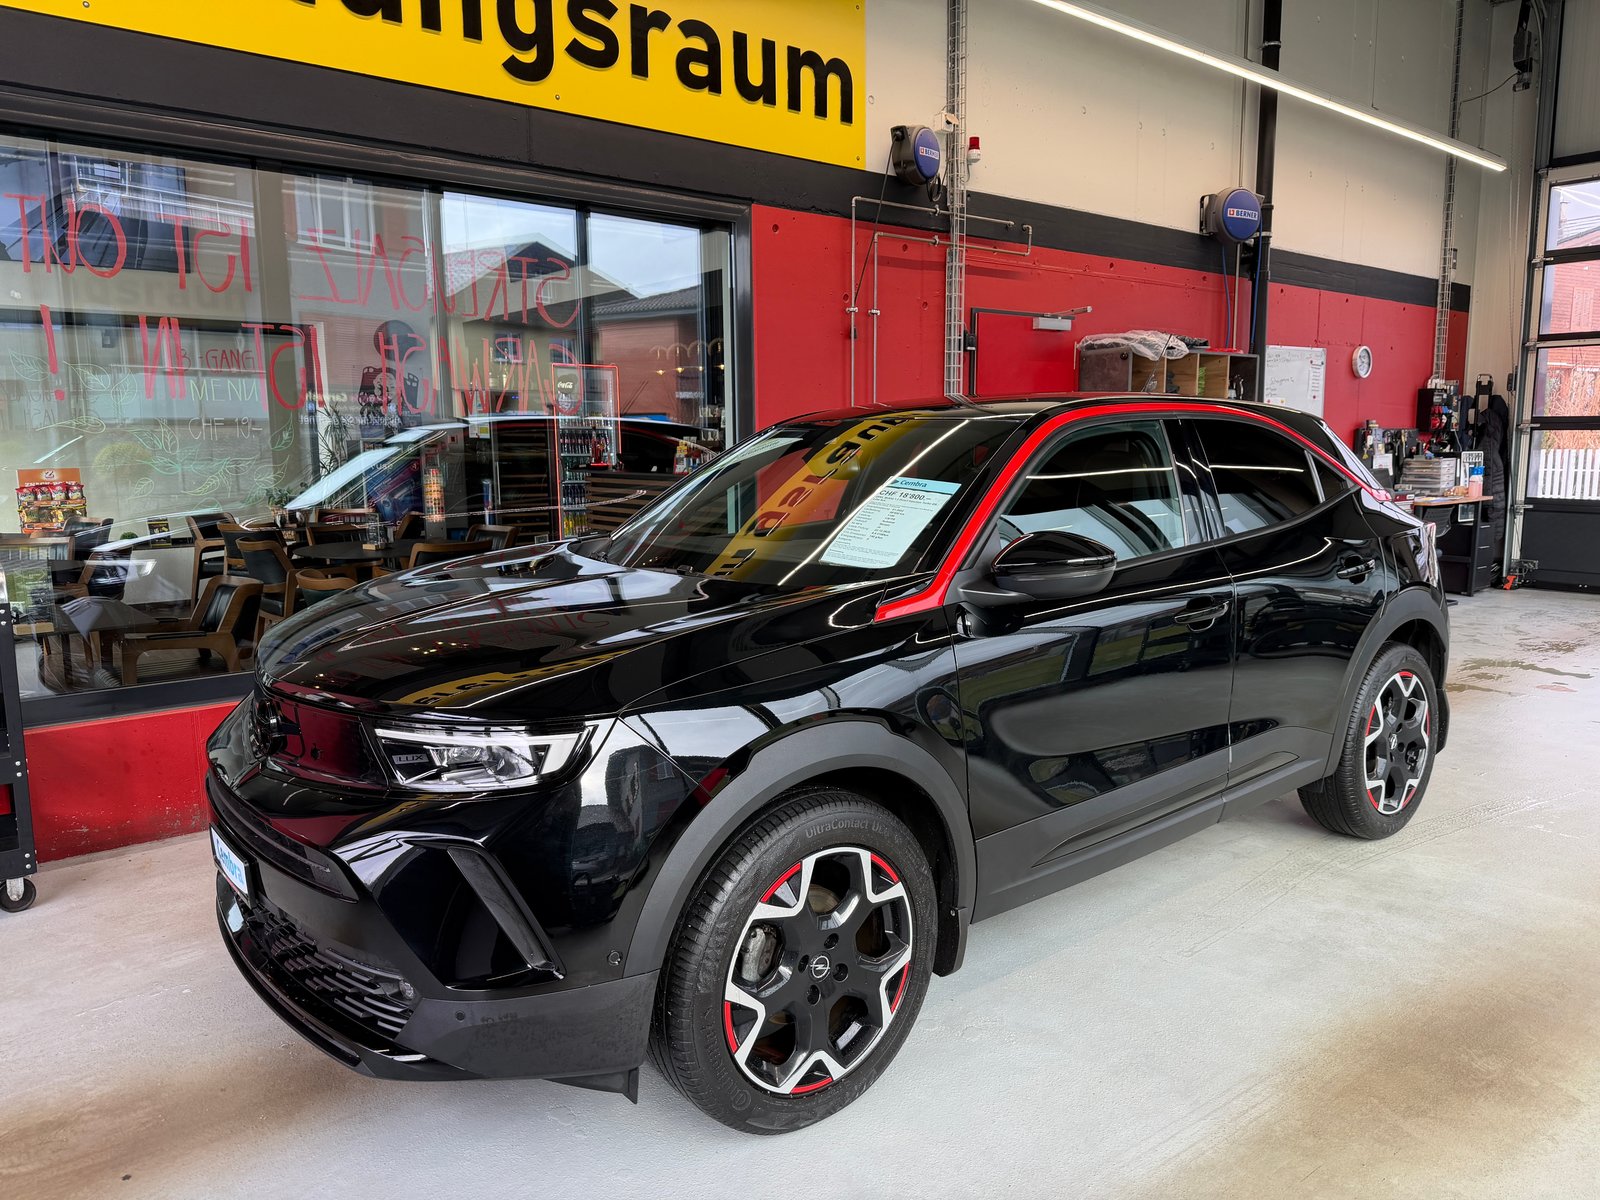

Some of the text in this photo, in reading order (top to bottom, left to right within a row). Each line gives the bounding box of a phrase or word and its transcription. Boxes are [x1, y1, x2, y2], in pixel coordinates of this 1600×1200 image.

[925, 148, 939, 158] BERNER
[1236, 210, 1257, 219] BERNER
[188, 417, 224, 440] CHF
[900, 480, 927, 488] Cembra
[805, 820, 868, 838] UltraContact
